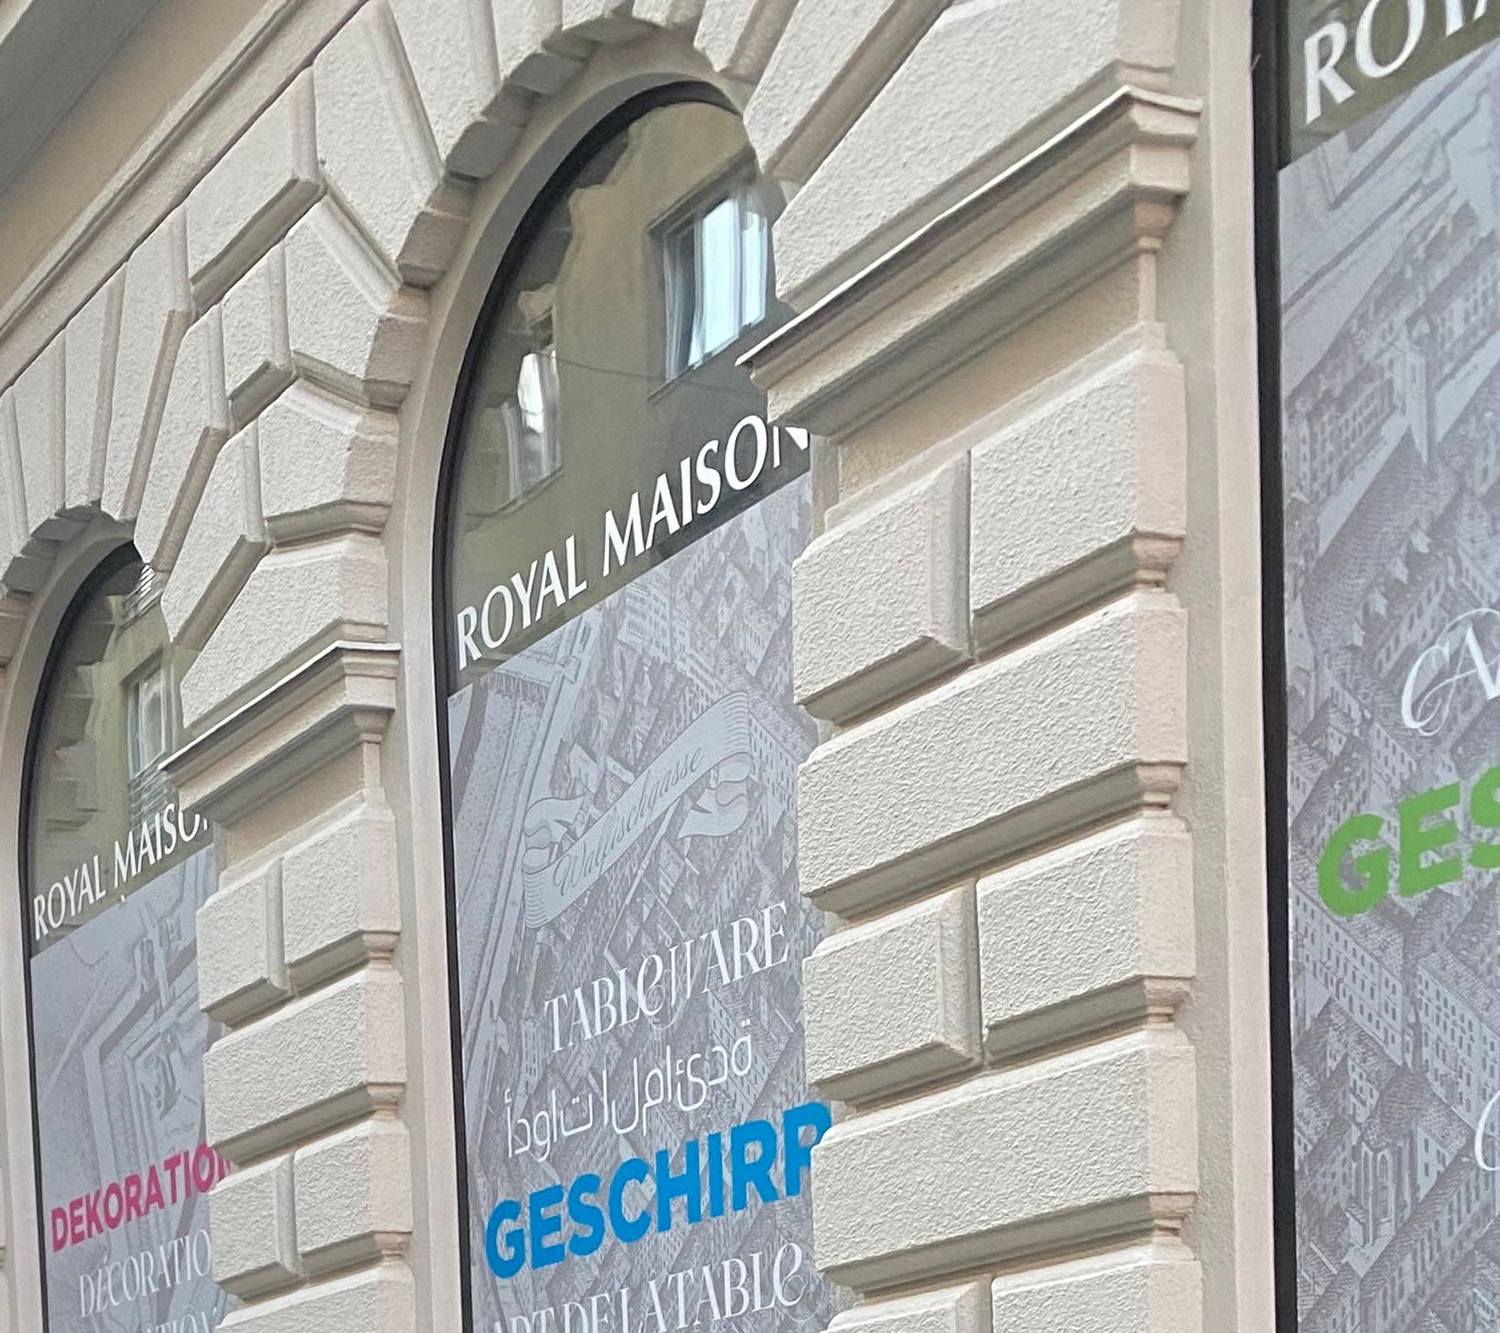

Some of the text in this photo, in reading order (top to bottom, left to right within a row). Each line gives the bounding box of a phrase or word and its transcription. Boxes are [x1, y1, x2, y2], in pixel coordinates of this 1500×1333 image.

[456, 535, 587, 670] ROYAL
[33, 803, 208, 941] ROYAL MAISO
[667, 1242, 807, 1331] TABLE
